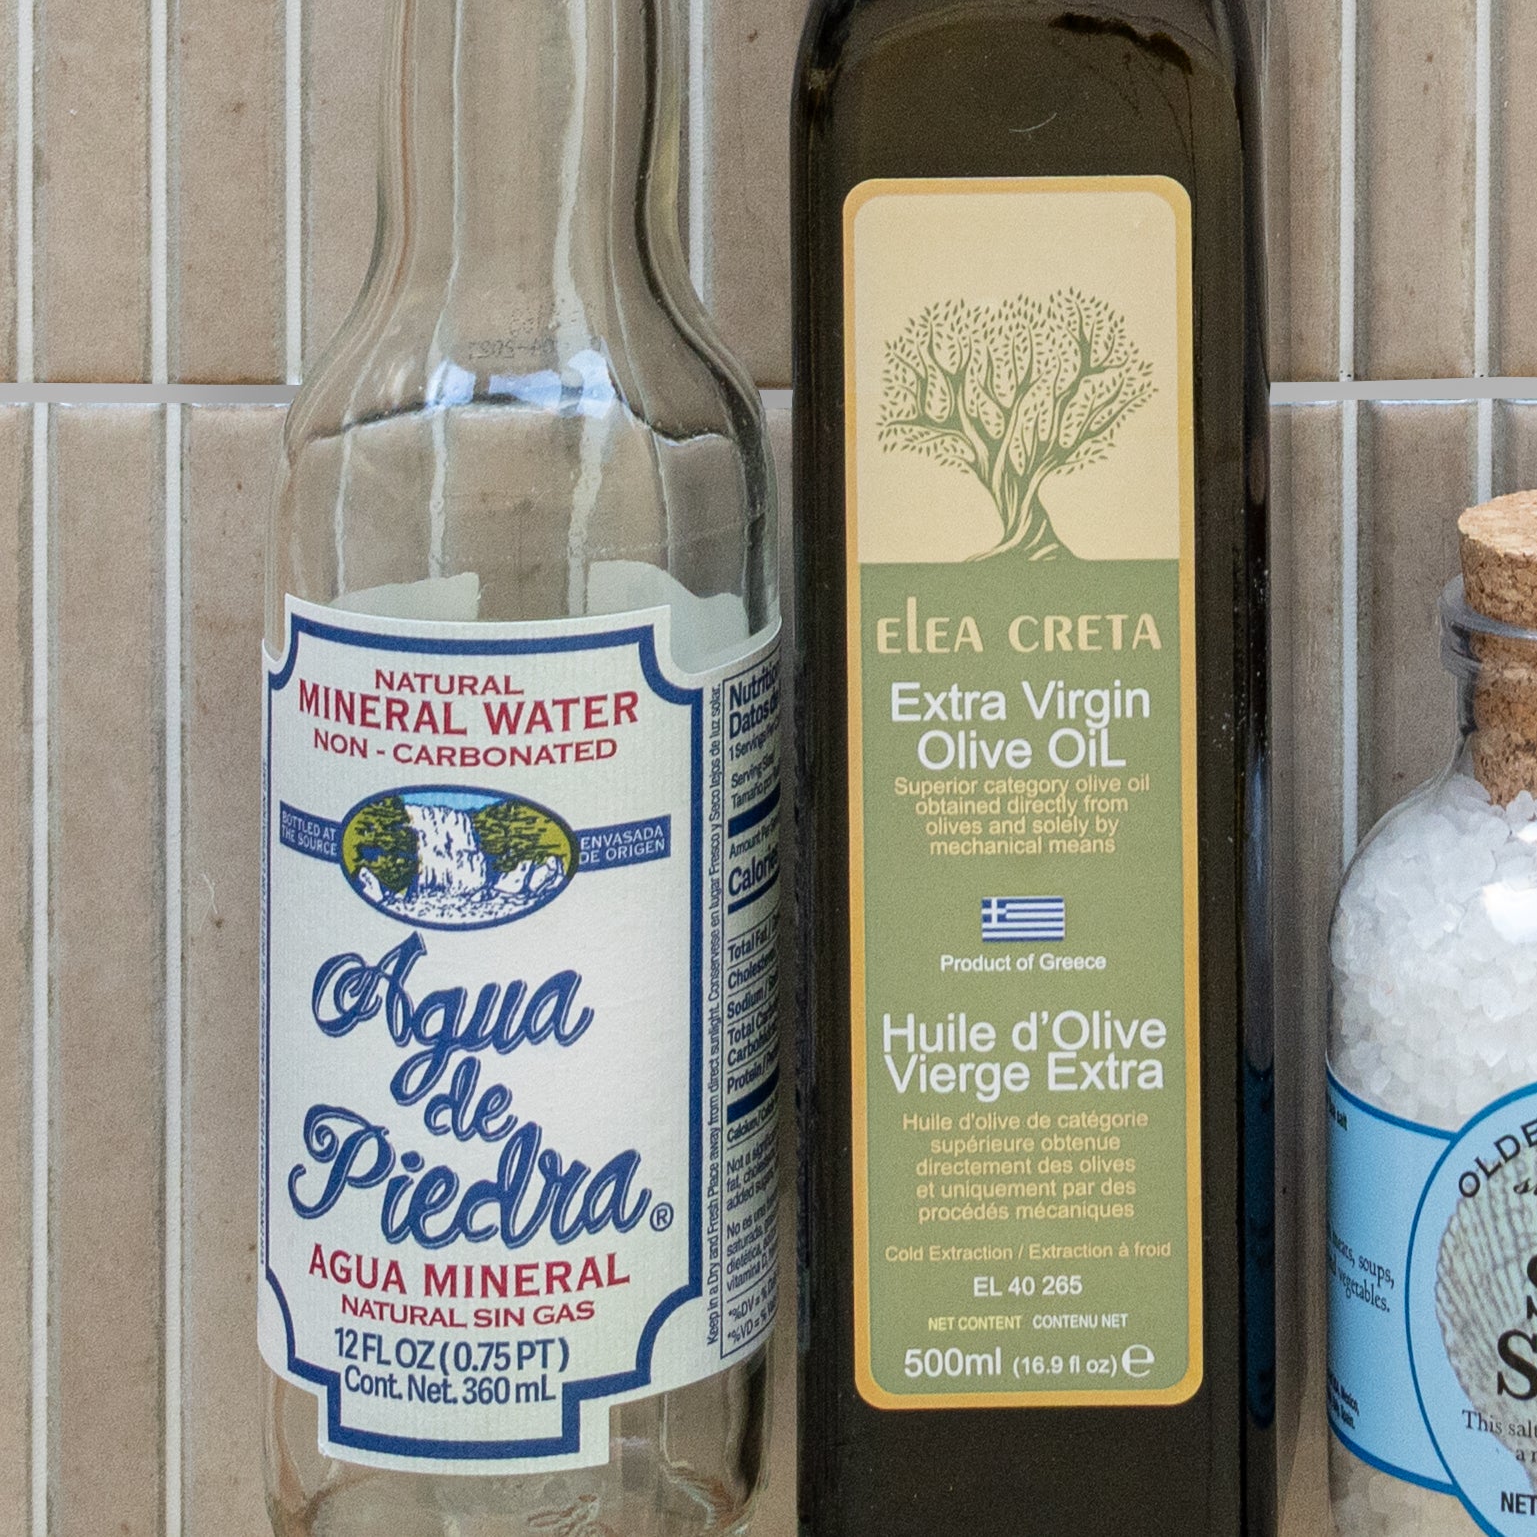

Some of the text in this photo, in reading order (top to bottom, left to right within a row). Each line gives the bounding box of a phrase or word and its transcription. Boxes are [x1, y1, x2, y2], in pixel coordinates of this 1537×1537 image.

[1007, 612, 1163, 654] CRETA
[374, 668, 525, 696] NATURAL
[298, 679, 639, 736] MINERAL WATER
[891, 678, 1151, 729] Extra Virgin
[709, 719, 720, 738] luz
[729, 701, 769, 740] Datos
[313, 728, 618, 767] NON CARBONATED
[709, 739, 720, 756] de
[917, 729, 1032, 771] Olive
[894, 773, 1150, 800] Superior category olive oil
[708, 789, 720, 822] Seco
[914, 794, 1129, 820] obtained directly from
[281, 824, 338, 856] THE SOURCE
[282, 810, 336, 841] BOTTLED AT
[580, 825, 664, 850] ENVASADA
[712, 823, 722, 832] y
[925, 815, 1120, 838] olives and solely by
[578, 838, 665, 865] DE ORIGEN
[708, 832, 720, 876] Fresco
[929, 837, 1116, 856] mechanical means
[711, 909, 720, 927] en
[728, 932, 755, 963] Total
[940, 952, 1107, 973] Product of Greece
[311, 930, 594, 1105] Agua
[728, 986, 764, 1020] Sodium
[708, 1002, 721, 1055] sunlight.
[728, 1017, 755, 1047] Total
[881, 1009, 1168, 1053] Huile d'Olive
[708, 1058, 719, 1093] direct
[727, 1065, 762, 1095] Protein
[884, 1051, 1164, 1103] Vierge Extra
[423, 1056, 518, 1142] de
[708, 1095, 719, 1125] from
[902, 1109, 1149, 1133] Huile d'olive de catégorie
[709, 1126, 721, 1161] away
[930, 1133, 1122, 1157] supérieure obtenue
[707, 1162, 719, 1197] Place
[915, 1155, 1137, 1177] directement des olives
[916, 1178, 1137, 1203] et uniquement par des
[707, 1197, 719, 1233] Fresh
[917, 1200, 1135, 1225] procédés mécaniques
[707, 1235, 719, 1260] and
[885, 1245, 925, 1262] Cold
[929, 1244, 1014, 1261] Extraction
[1028, 1242, 1114, 1260] Extraction
[1118, 1241, 1129, 1258] à
[1133, 1240, 1172, 1258] froid
[308, 1243, 631, 1298] AGUA MINERAL
[707, 1261, 721, 1284] Dry
[1358, 1254, 1395, 1290] soups,
[709, 1284, 719, 1295] a
[973, 1275, 1083, 1298] EL 40 265
[1337, 1266, 1390, 1313] vegetables.
[340, 1294, 595, 1329] NATURAL SIN GAS
[707, 1297, 719, 1311] in
[707, 1311, 721, 1346] Keep
[928, 1313, 1129, 1331] NET CONTENT CONTENU NET
[394, 1338, 435, 1370] OZ
[903, 1347, 1002, 1378] 500ml
[1012, 1356, 1065, 1380] (16.9
[1069, 1355, 1081, 1375] fl
[1086, 1354, 1118, 1378] oz)
[343, 1366, 557, 1405] Cont. Net. 360 mL
[1461, 1408, 1503, 1436] This
[1514, 1449, 1525, 1462] a
[1501, 1491, 1537, 1516] NET
